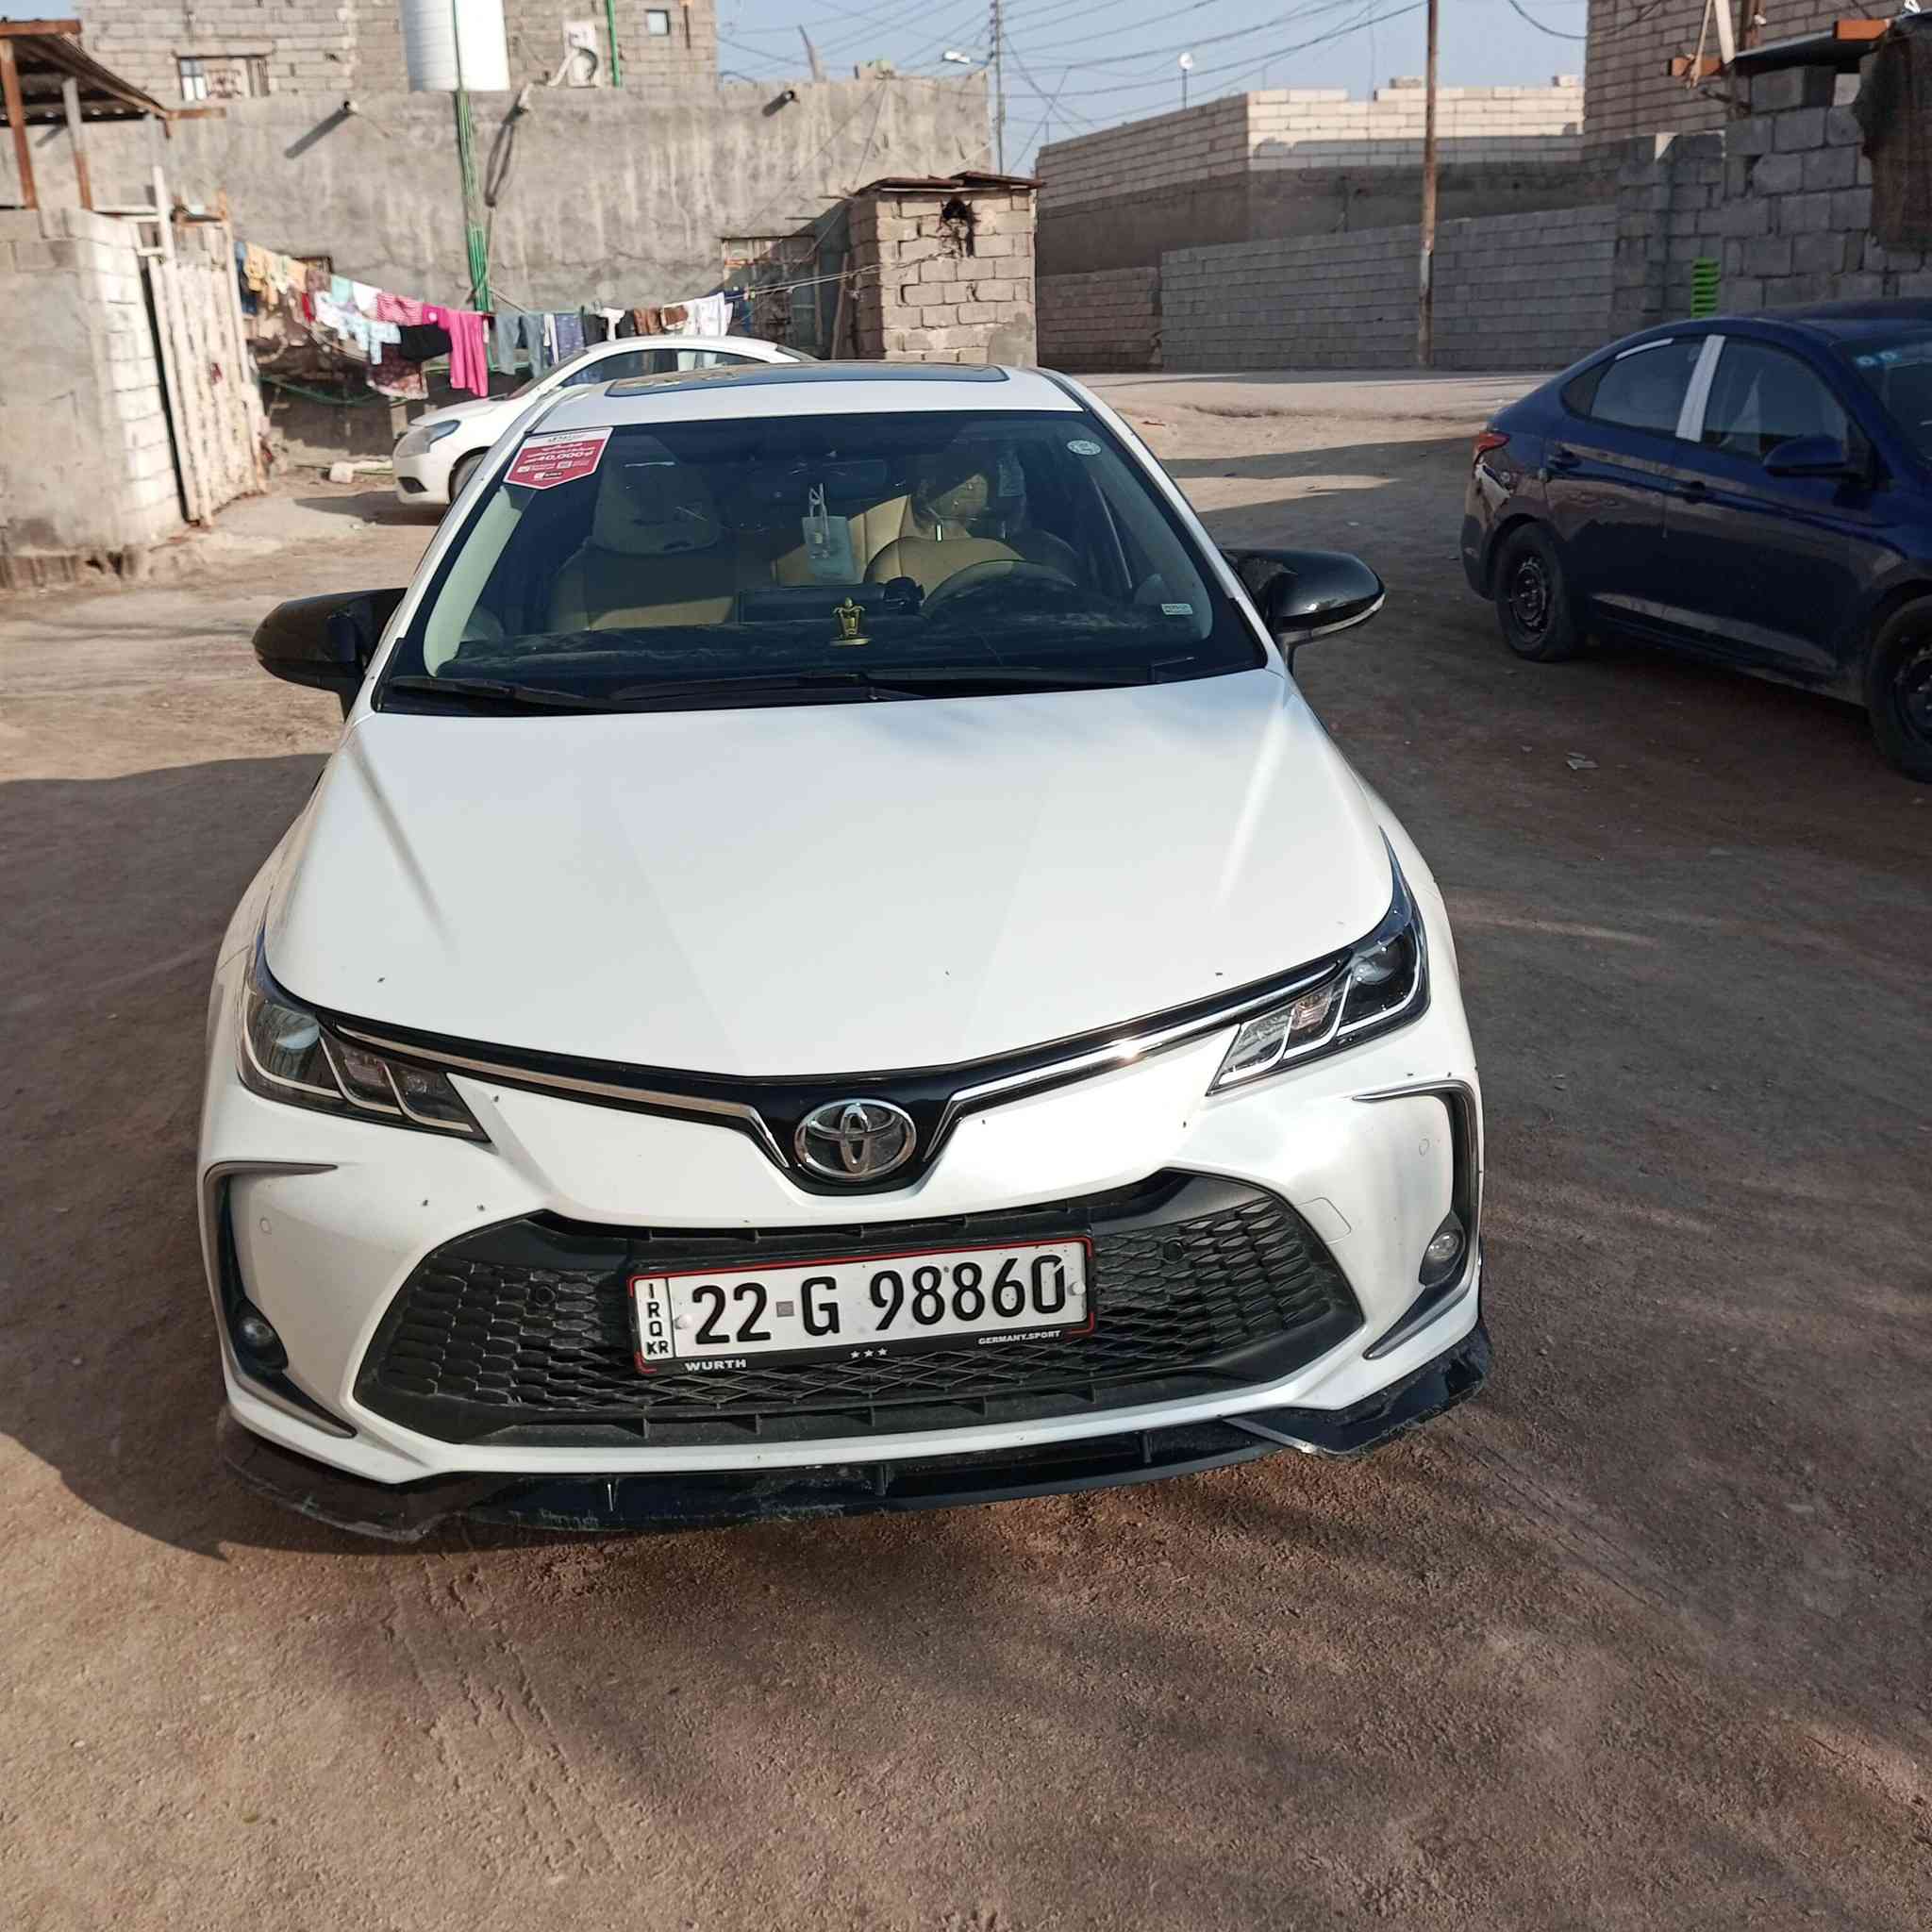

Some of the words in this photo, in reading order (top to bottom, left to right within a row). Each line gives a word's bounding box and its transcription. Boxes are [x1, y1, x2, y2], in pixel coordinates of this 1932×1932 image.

[691, 1282, 771, 1345] 22
[800, 1275, 841, 1337] G
[870, 1255, 1066, 1331] 98860
[646, 1340, 669, 1356] KR
[684, 1358, 747, 1372] WURTH
